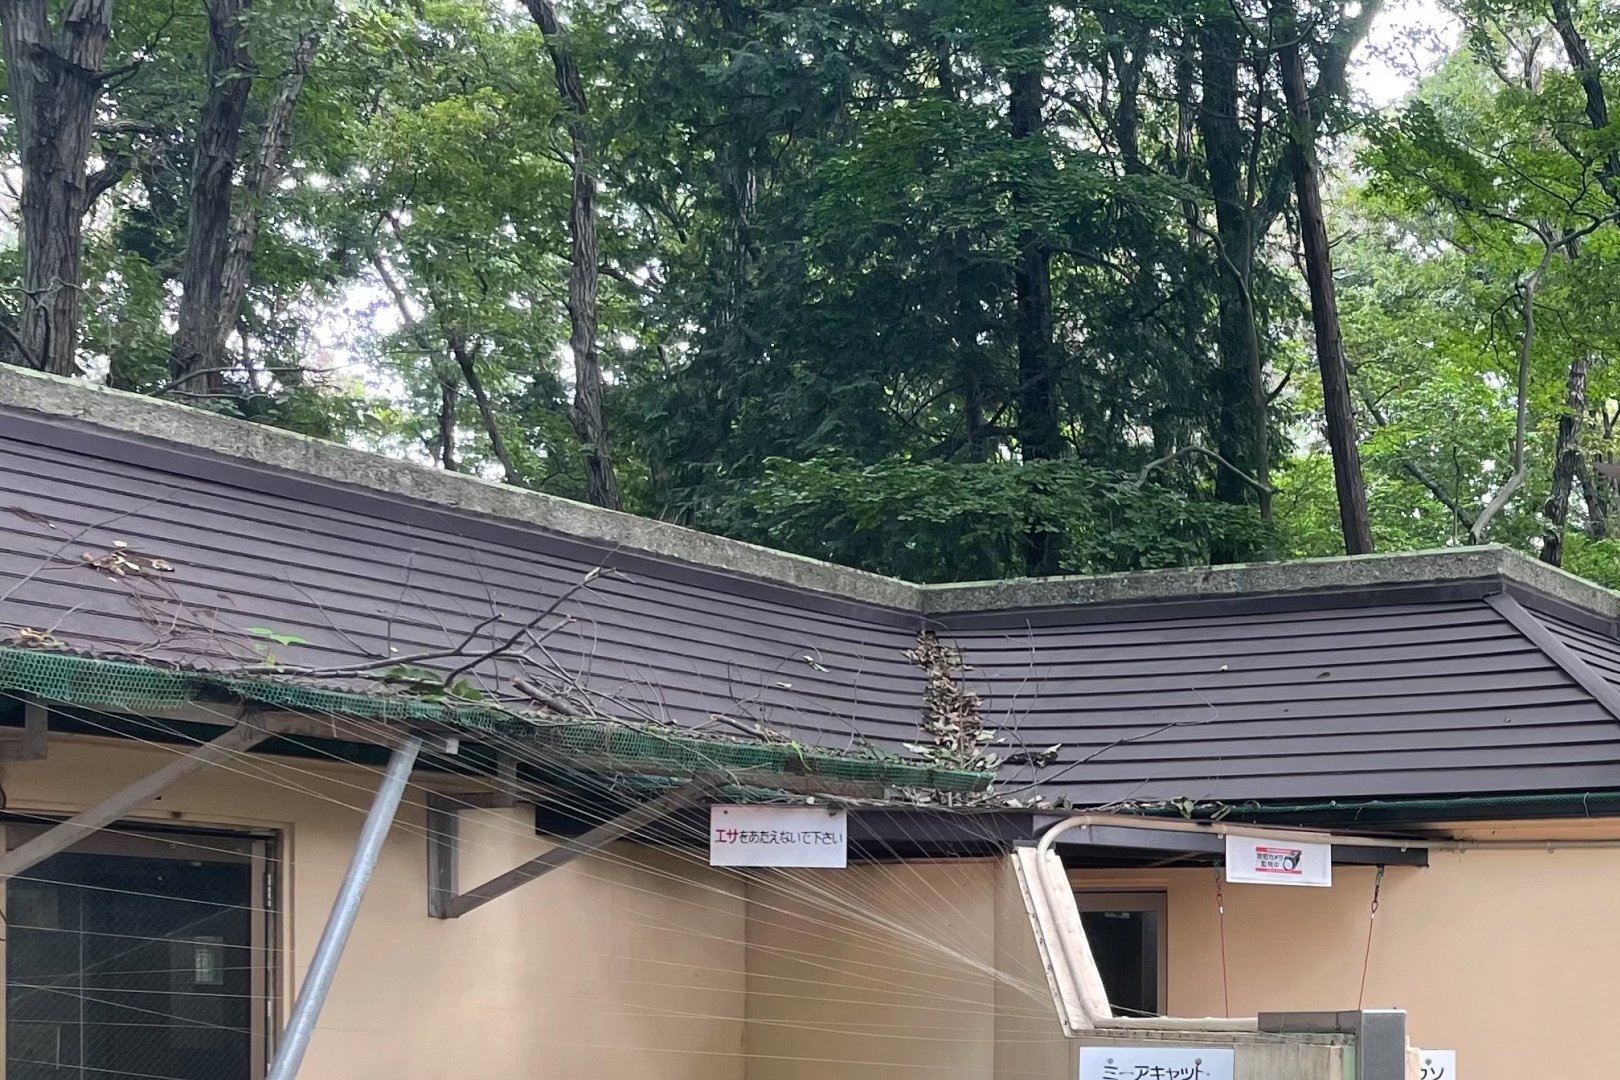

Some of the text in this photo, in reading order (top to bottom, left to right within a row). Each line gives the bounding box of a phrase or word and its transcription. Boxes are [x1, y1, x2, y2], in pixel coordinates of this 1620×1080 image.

[714, 829, 844, 845] エサをあたえないで下さい
